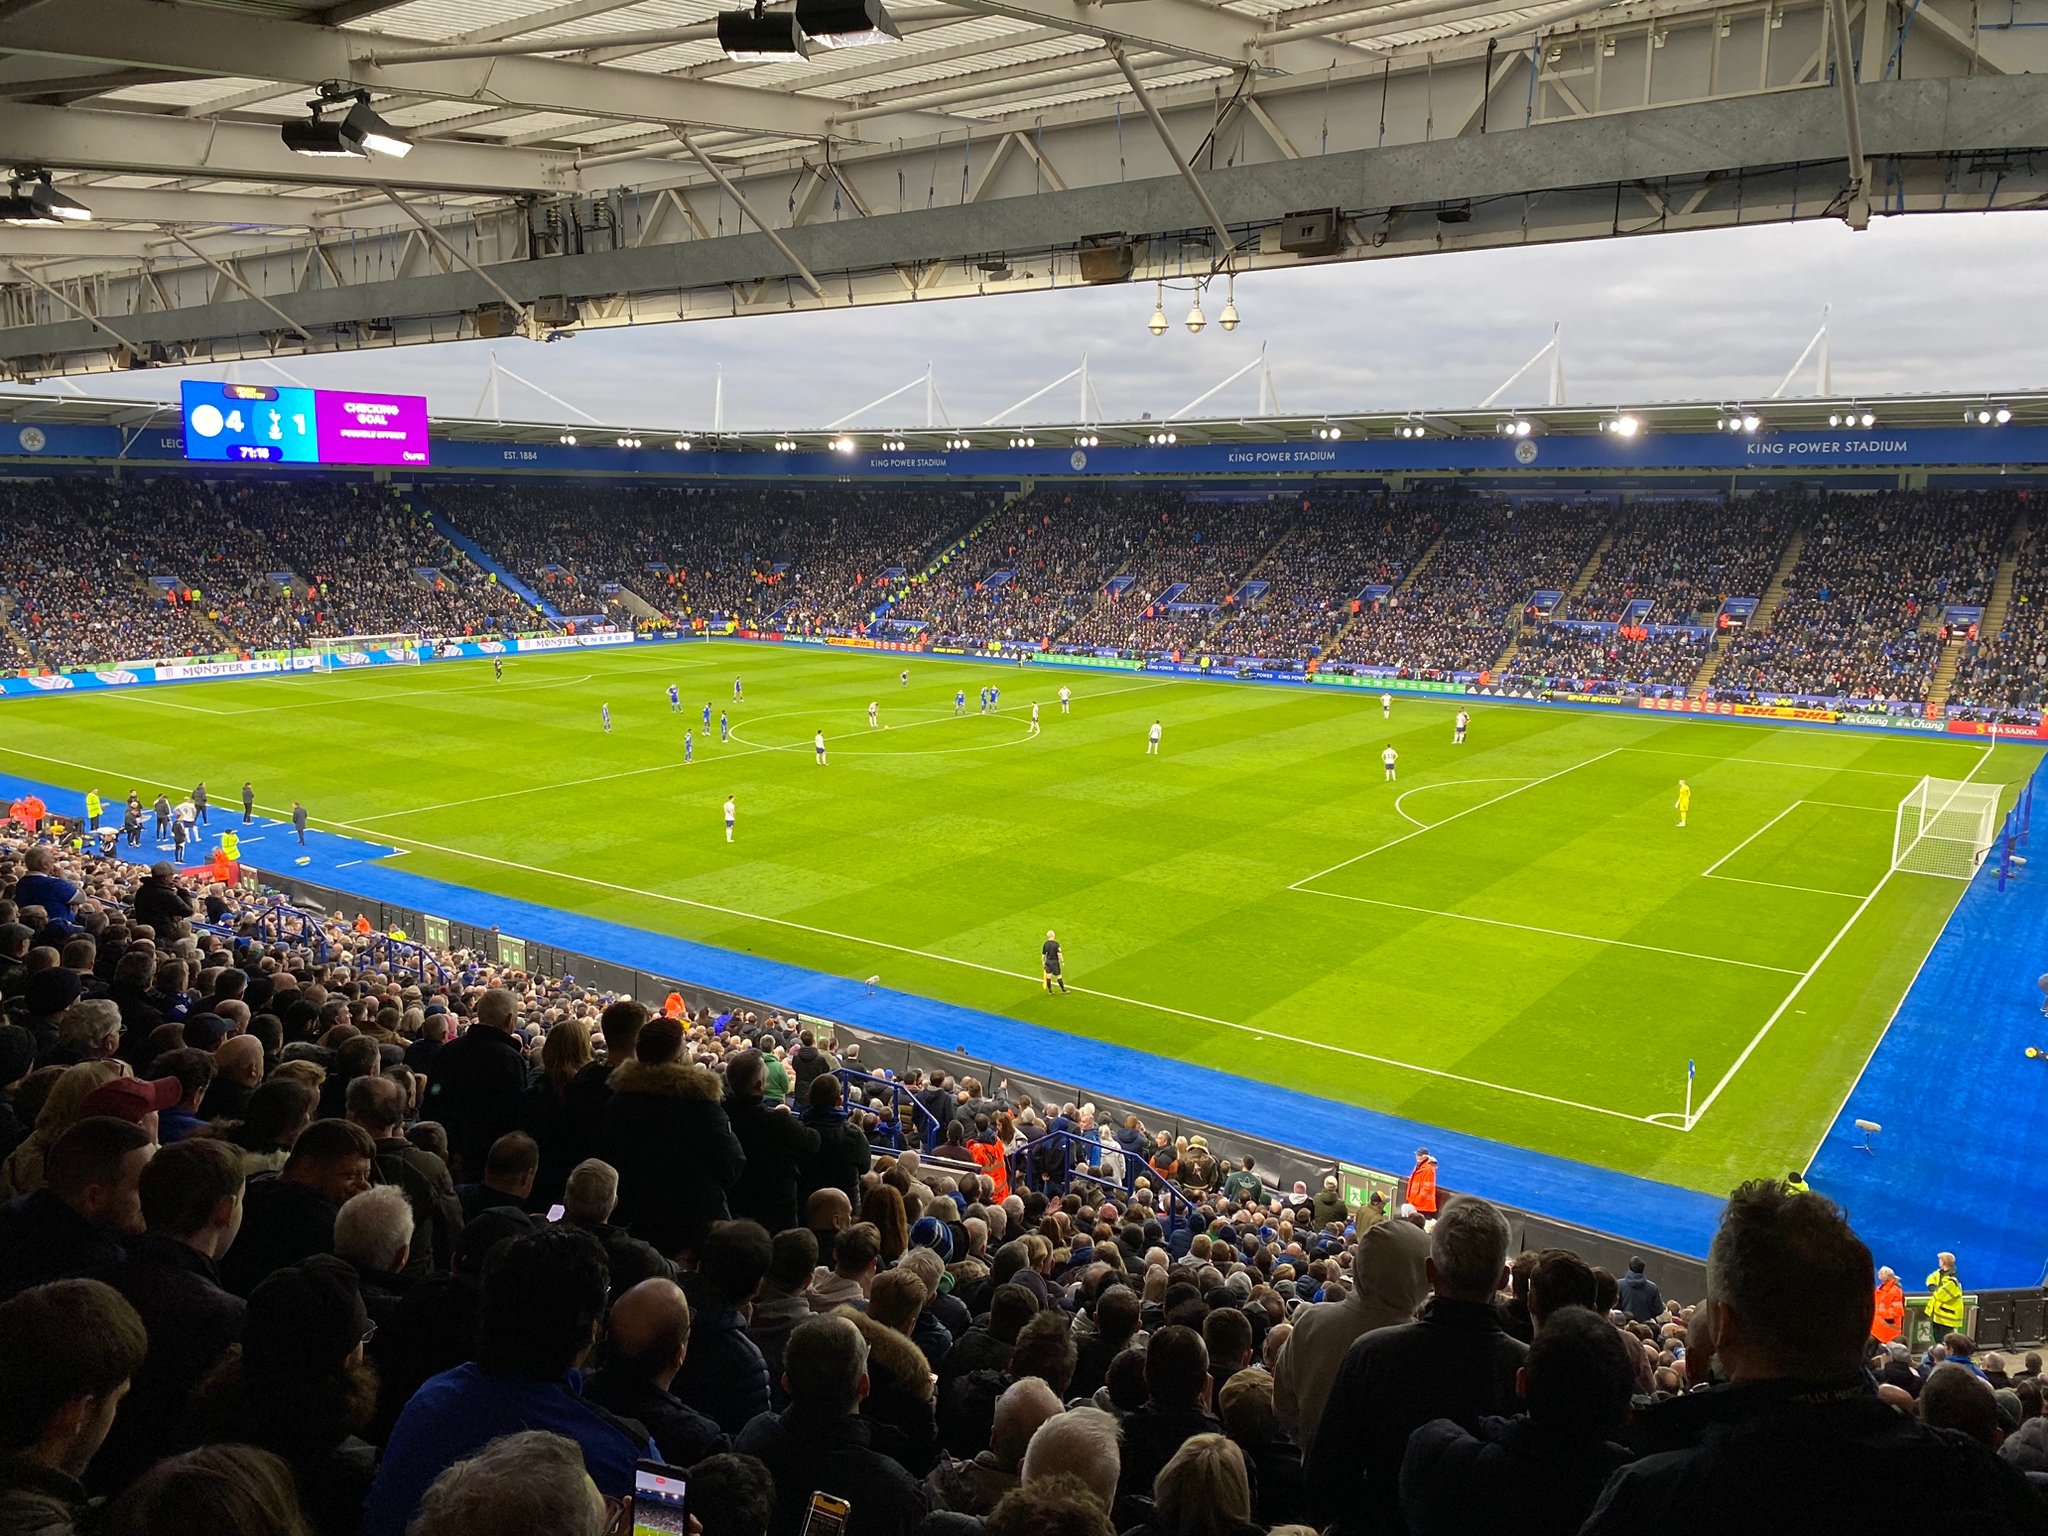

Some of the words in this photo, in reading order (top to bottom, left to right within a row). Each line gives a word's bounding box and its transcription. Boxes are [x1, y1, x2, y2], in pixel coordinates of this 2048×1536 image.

[343, 402, 399, 415] CHECKING
[225, 410, 245, 433] 4
[292, 413, 306, 435] 1
[356, 413, 389, 425] GOAL
[1747, 443, 1784, 454] KING
[1788, 442, 1840, 453] POWER
[1844, 441, 1907, 452] STADIUM
[503, 451, 519, 460] EST.
[520, 451, 538, 460] 1884
[1228, 453, 1254, 462] KING
[1256, 452, 1291, 462] POWER
[1293, 451, 1336, 461] STADIUM
[870, 459, 889, 467] KING
[890, 459, 916, 467] POWER
[917, 458, 947, 467] STADIUM
[182, 663, 245, 677] MONSTER
[1741, 706, 1779, 716] DHL
[1792, 710, 1831, 720] DHL
[1856, 714, 1888, 727] Chang
[1911, 718, 1945, 732] Chang
[1987, 726, 2004, 734] BA
